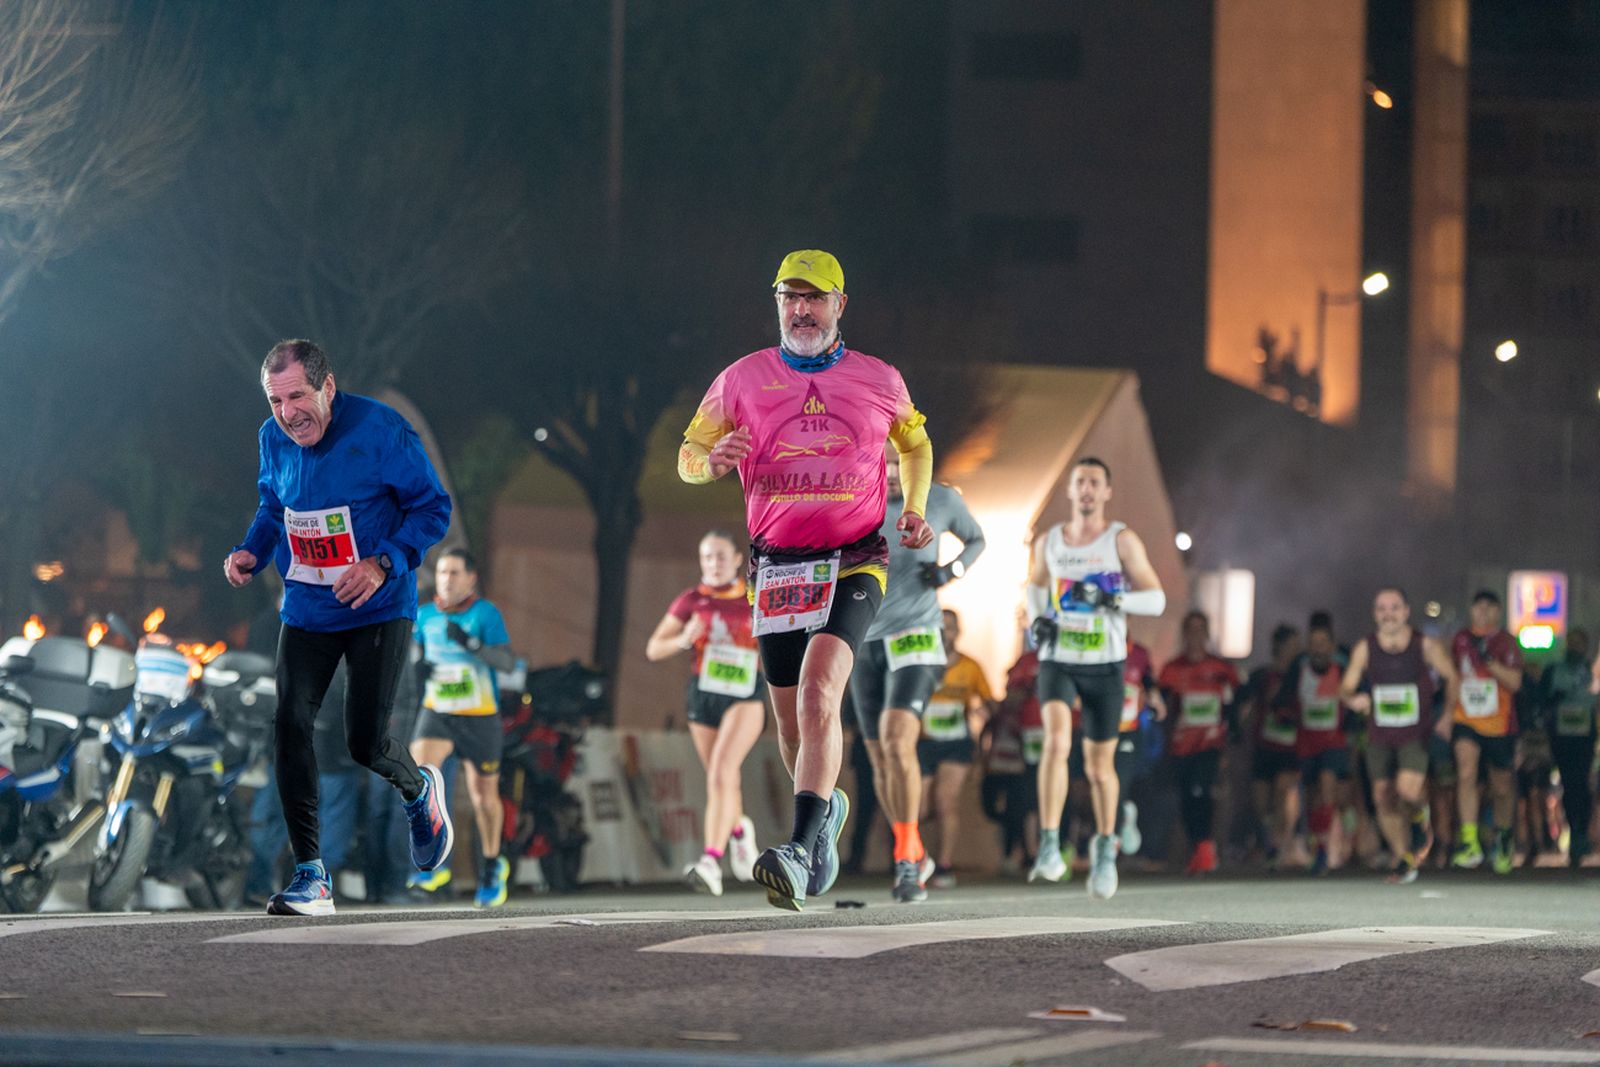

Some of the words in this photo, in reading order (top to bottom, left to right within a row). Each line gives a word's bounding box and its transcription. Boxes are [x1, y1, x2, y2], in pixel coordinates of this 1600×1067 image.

[800, 418, 830, 433] 21K
[760, 473, 813, 491] SILVIA
[819, 471, 867, 491] LARA
[298, 537, 340, 560] 9151
[773, 569, 798, 578] NOCHE
[765, 579, 781, 589] SAN
